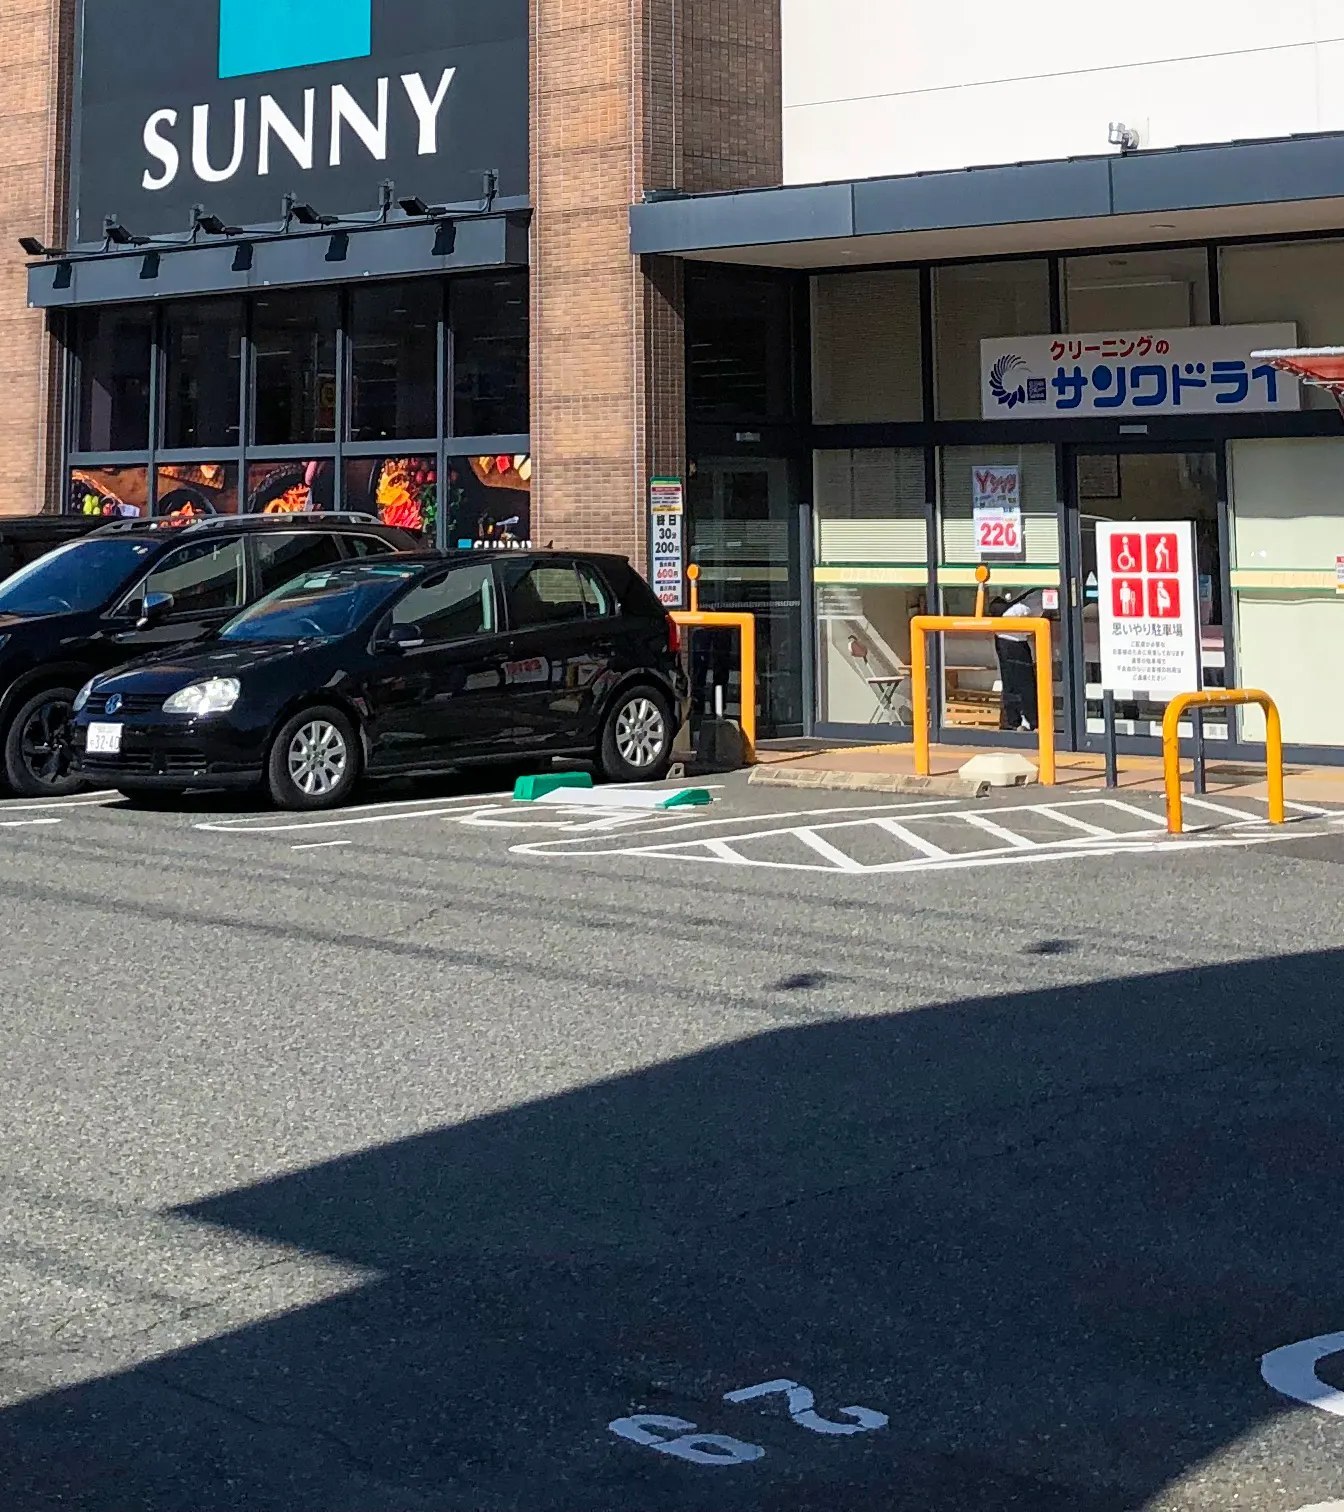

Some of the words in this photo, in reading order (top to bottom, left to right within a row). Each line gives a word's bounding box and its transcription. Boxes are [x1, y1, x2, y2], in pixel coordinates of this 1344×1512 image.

[141, 66, 456, 190] SUNNY
[1050, 335, 1169, 361] クリーニングの
[1051, 361, 1280, 410] サンワドライ
[1112, 622, 1183, 637] 思いやり駐車場
[608, 1378, 889, 1465] 29
